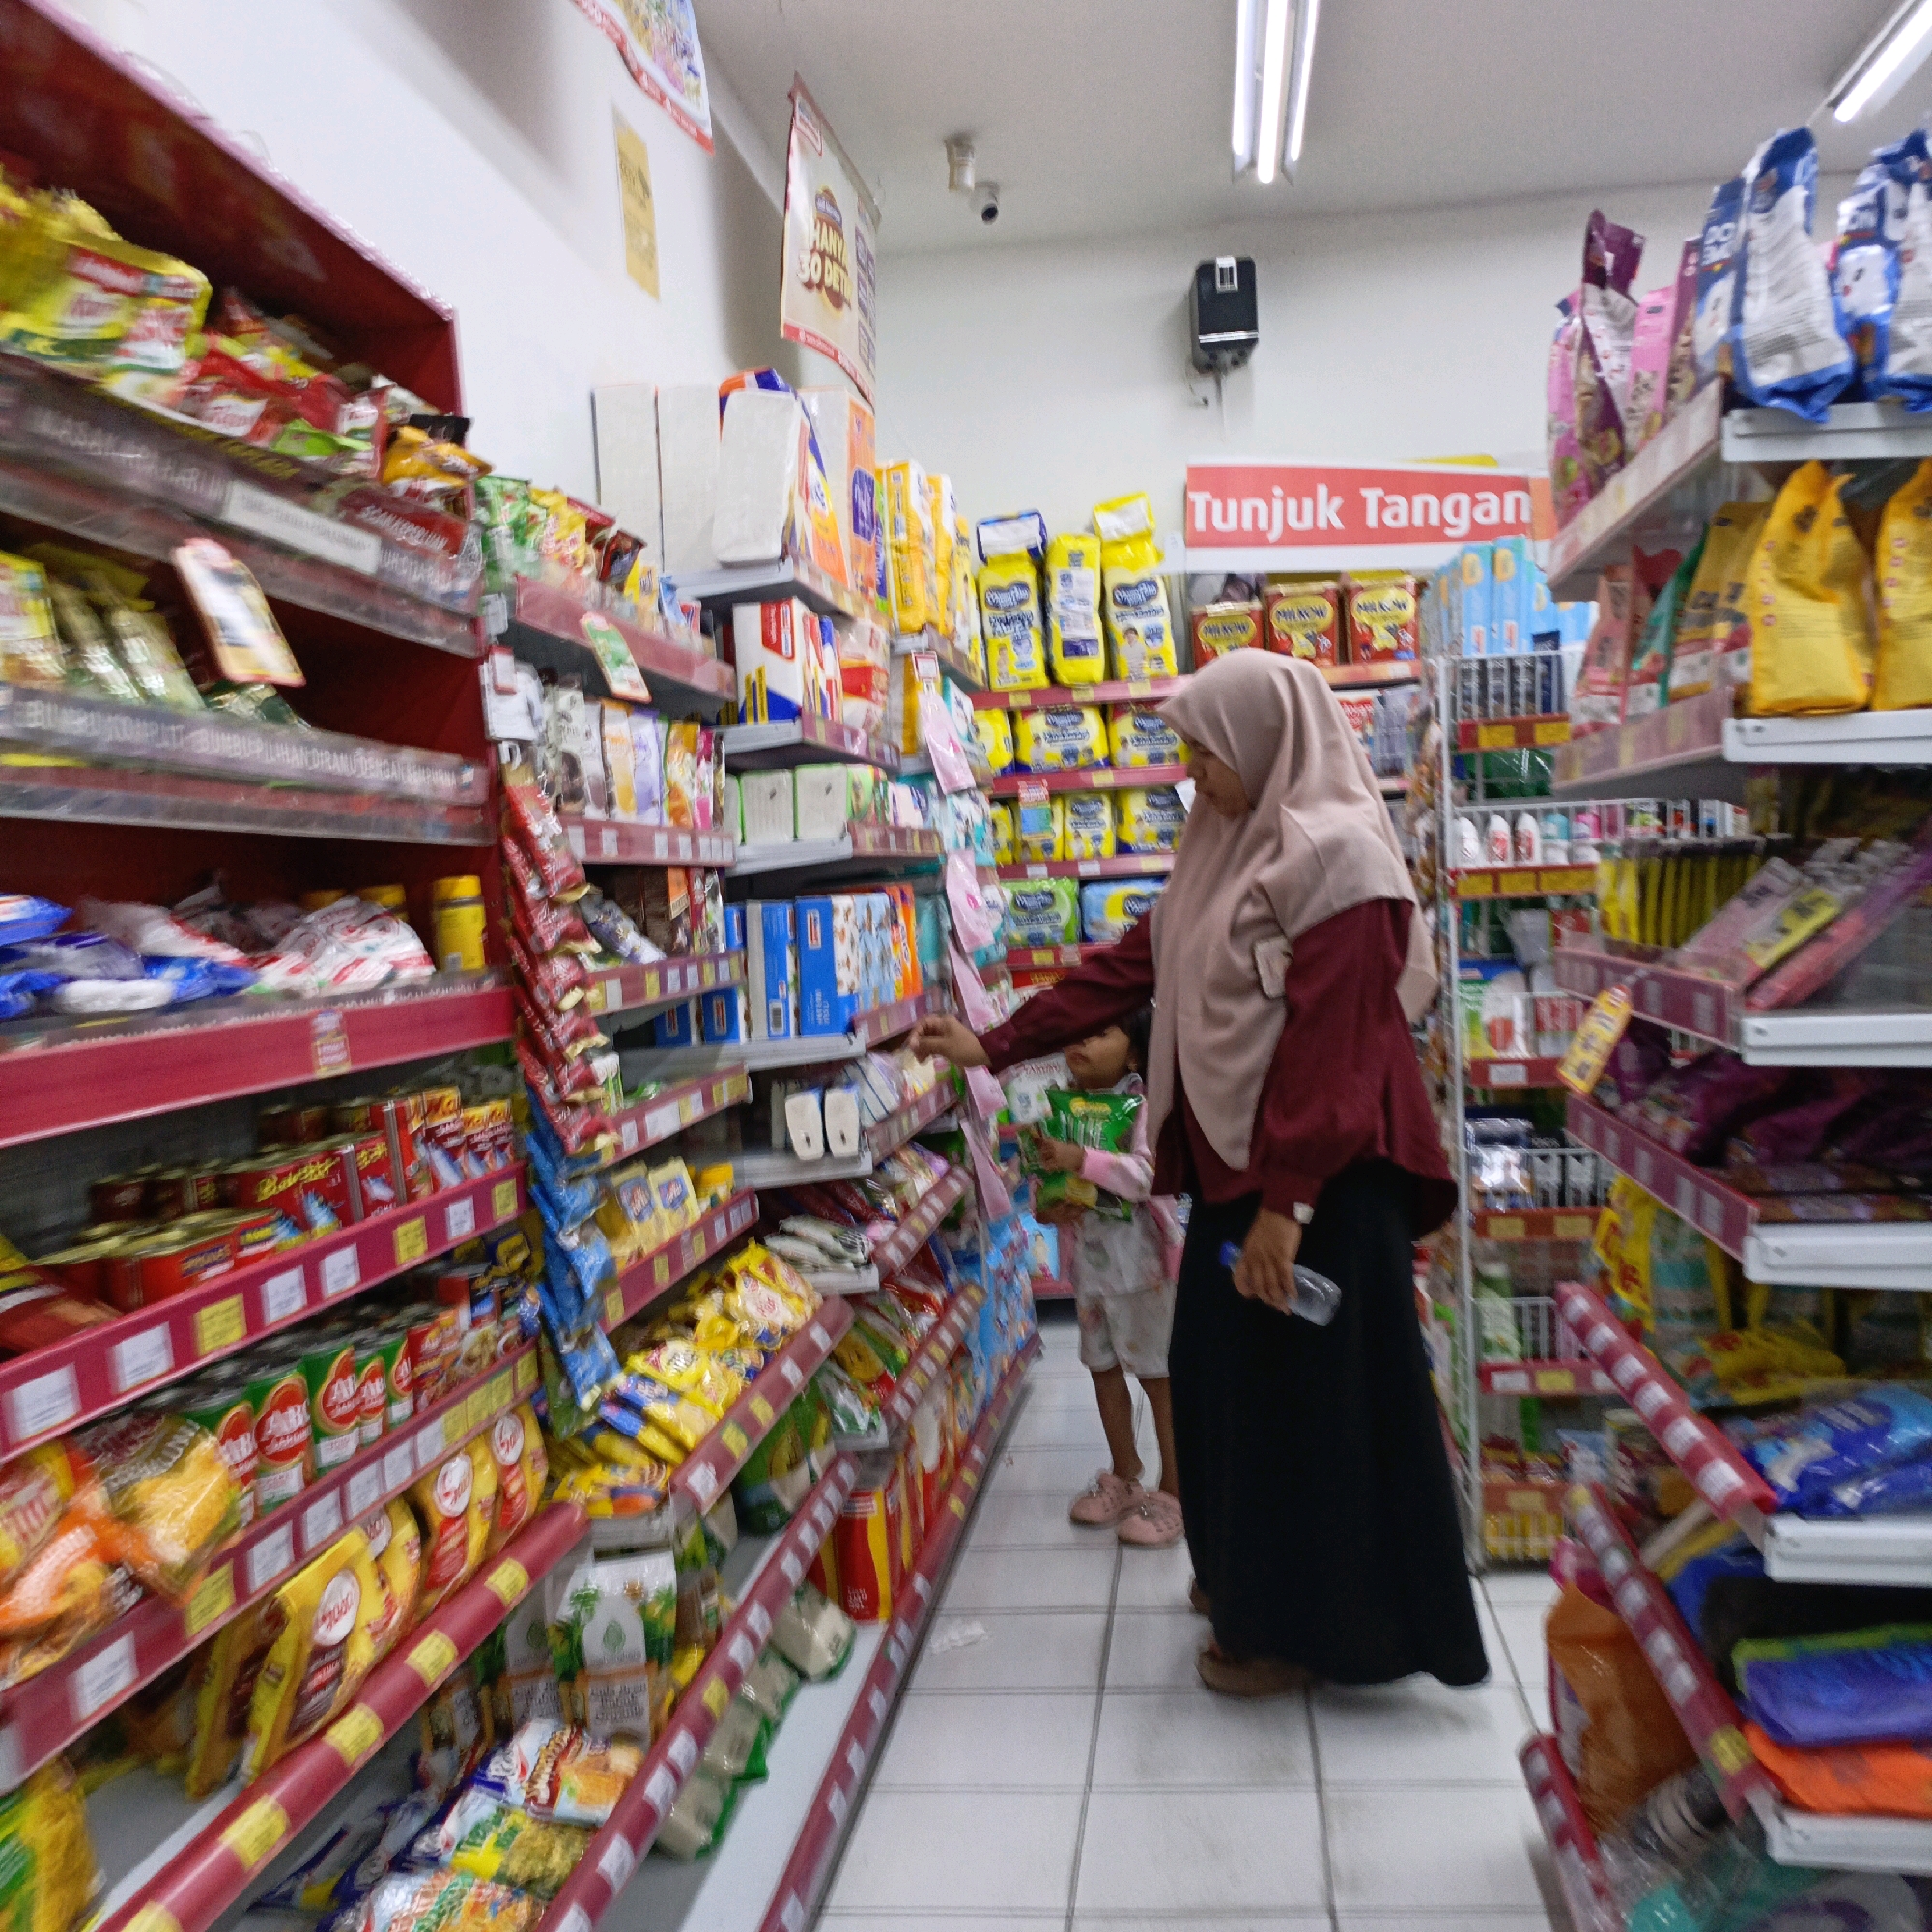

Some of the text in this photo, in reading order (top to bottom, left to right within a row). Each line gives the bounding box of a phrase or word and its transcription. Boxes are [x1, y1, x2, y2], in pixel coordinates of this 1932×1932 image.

[798, 252, 822, 284] 30
[1189, 483, 1532, 543] Tunjuk Tangan
